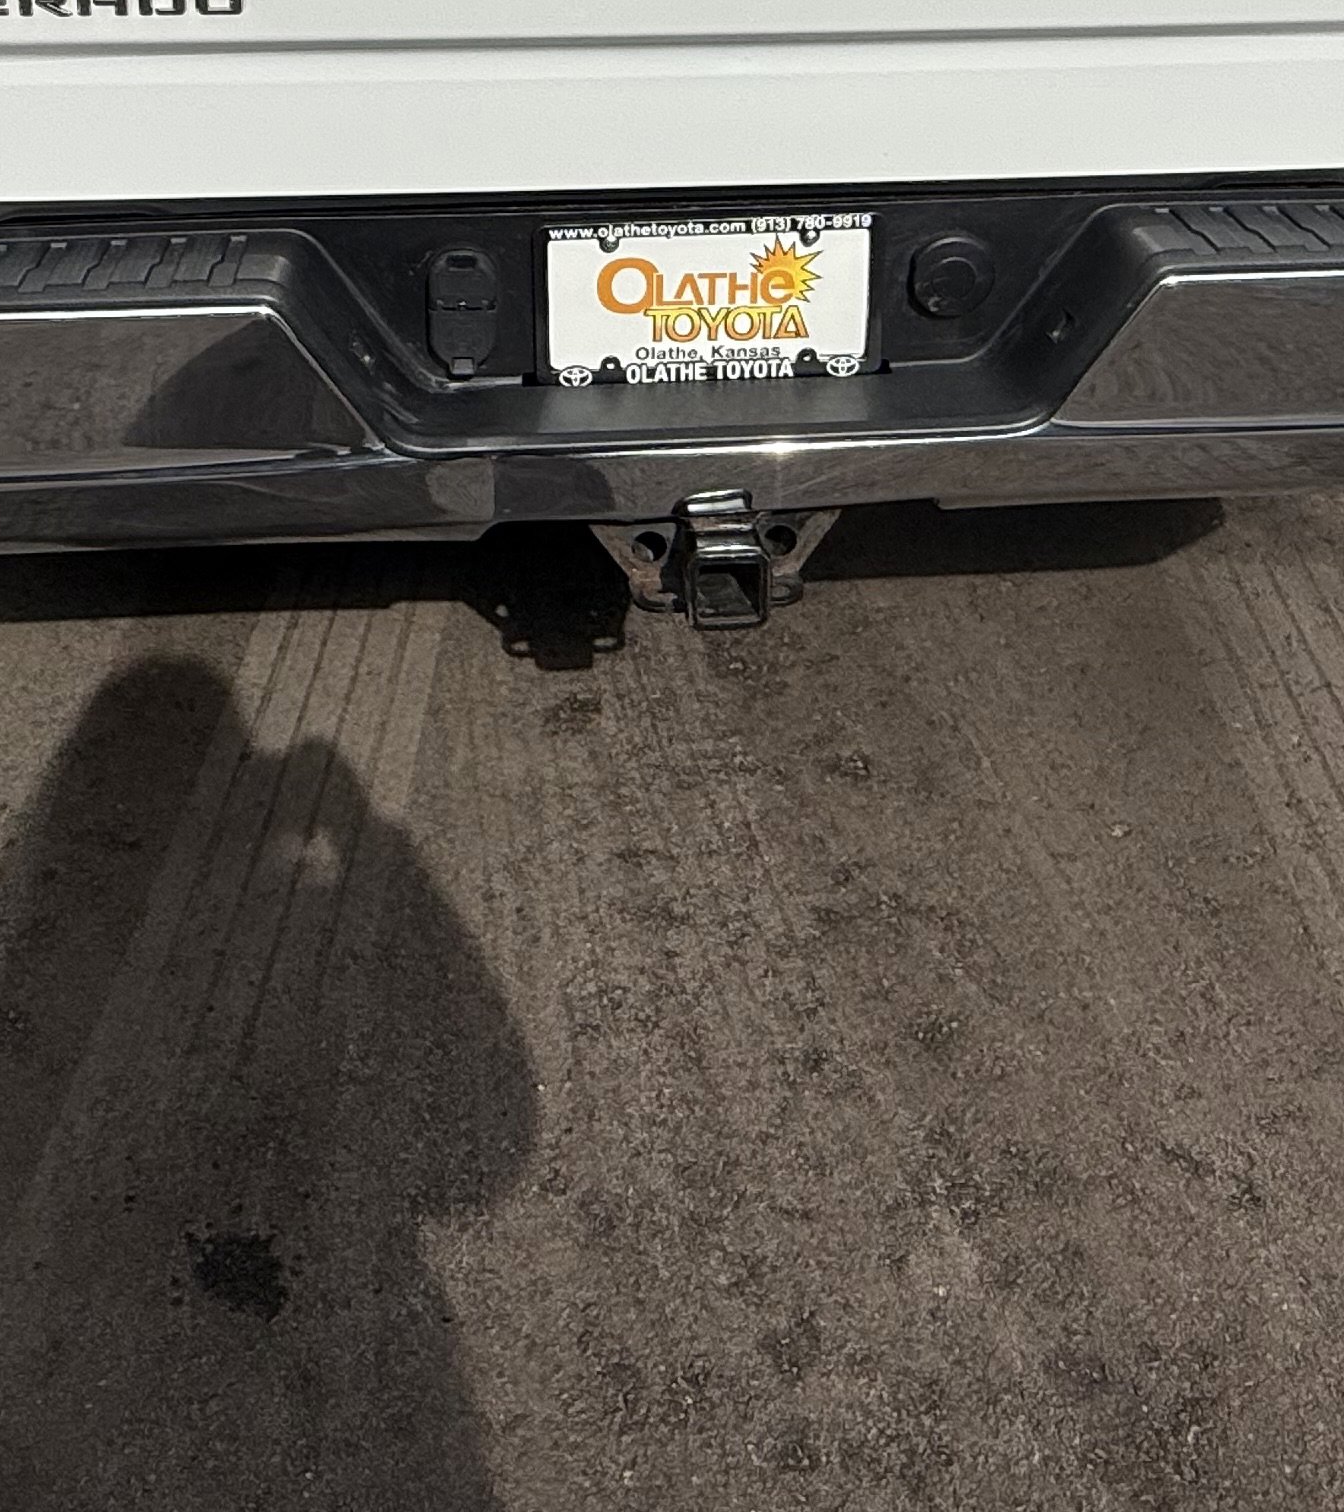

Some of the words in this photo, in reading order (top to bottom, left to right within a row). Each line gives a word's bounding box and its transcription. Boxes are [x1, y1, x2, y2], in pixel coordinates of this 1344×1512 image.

[548, 219, 746, 241] www.olathetoyota.com
[751, 215, 792, 234] (913)
[644, 304, 809, 343] TOYOTA
[635, 346, 705, 361] Olathe,
[710, 344, 782, 360] Kansas
[626, 360, 707, 385] OLATHE
[713, 357, 794, 381] TOYOTA
